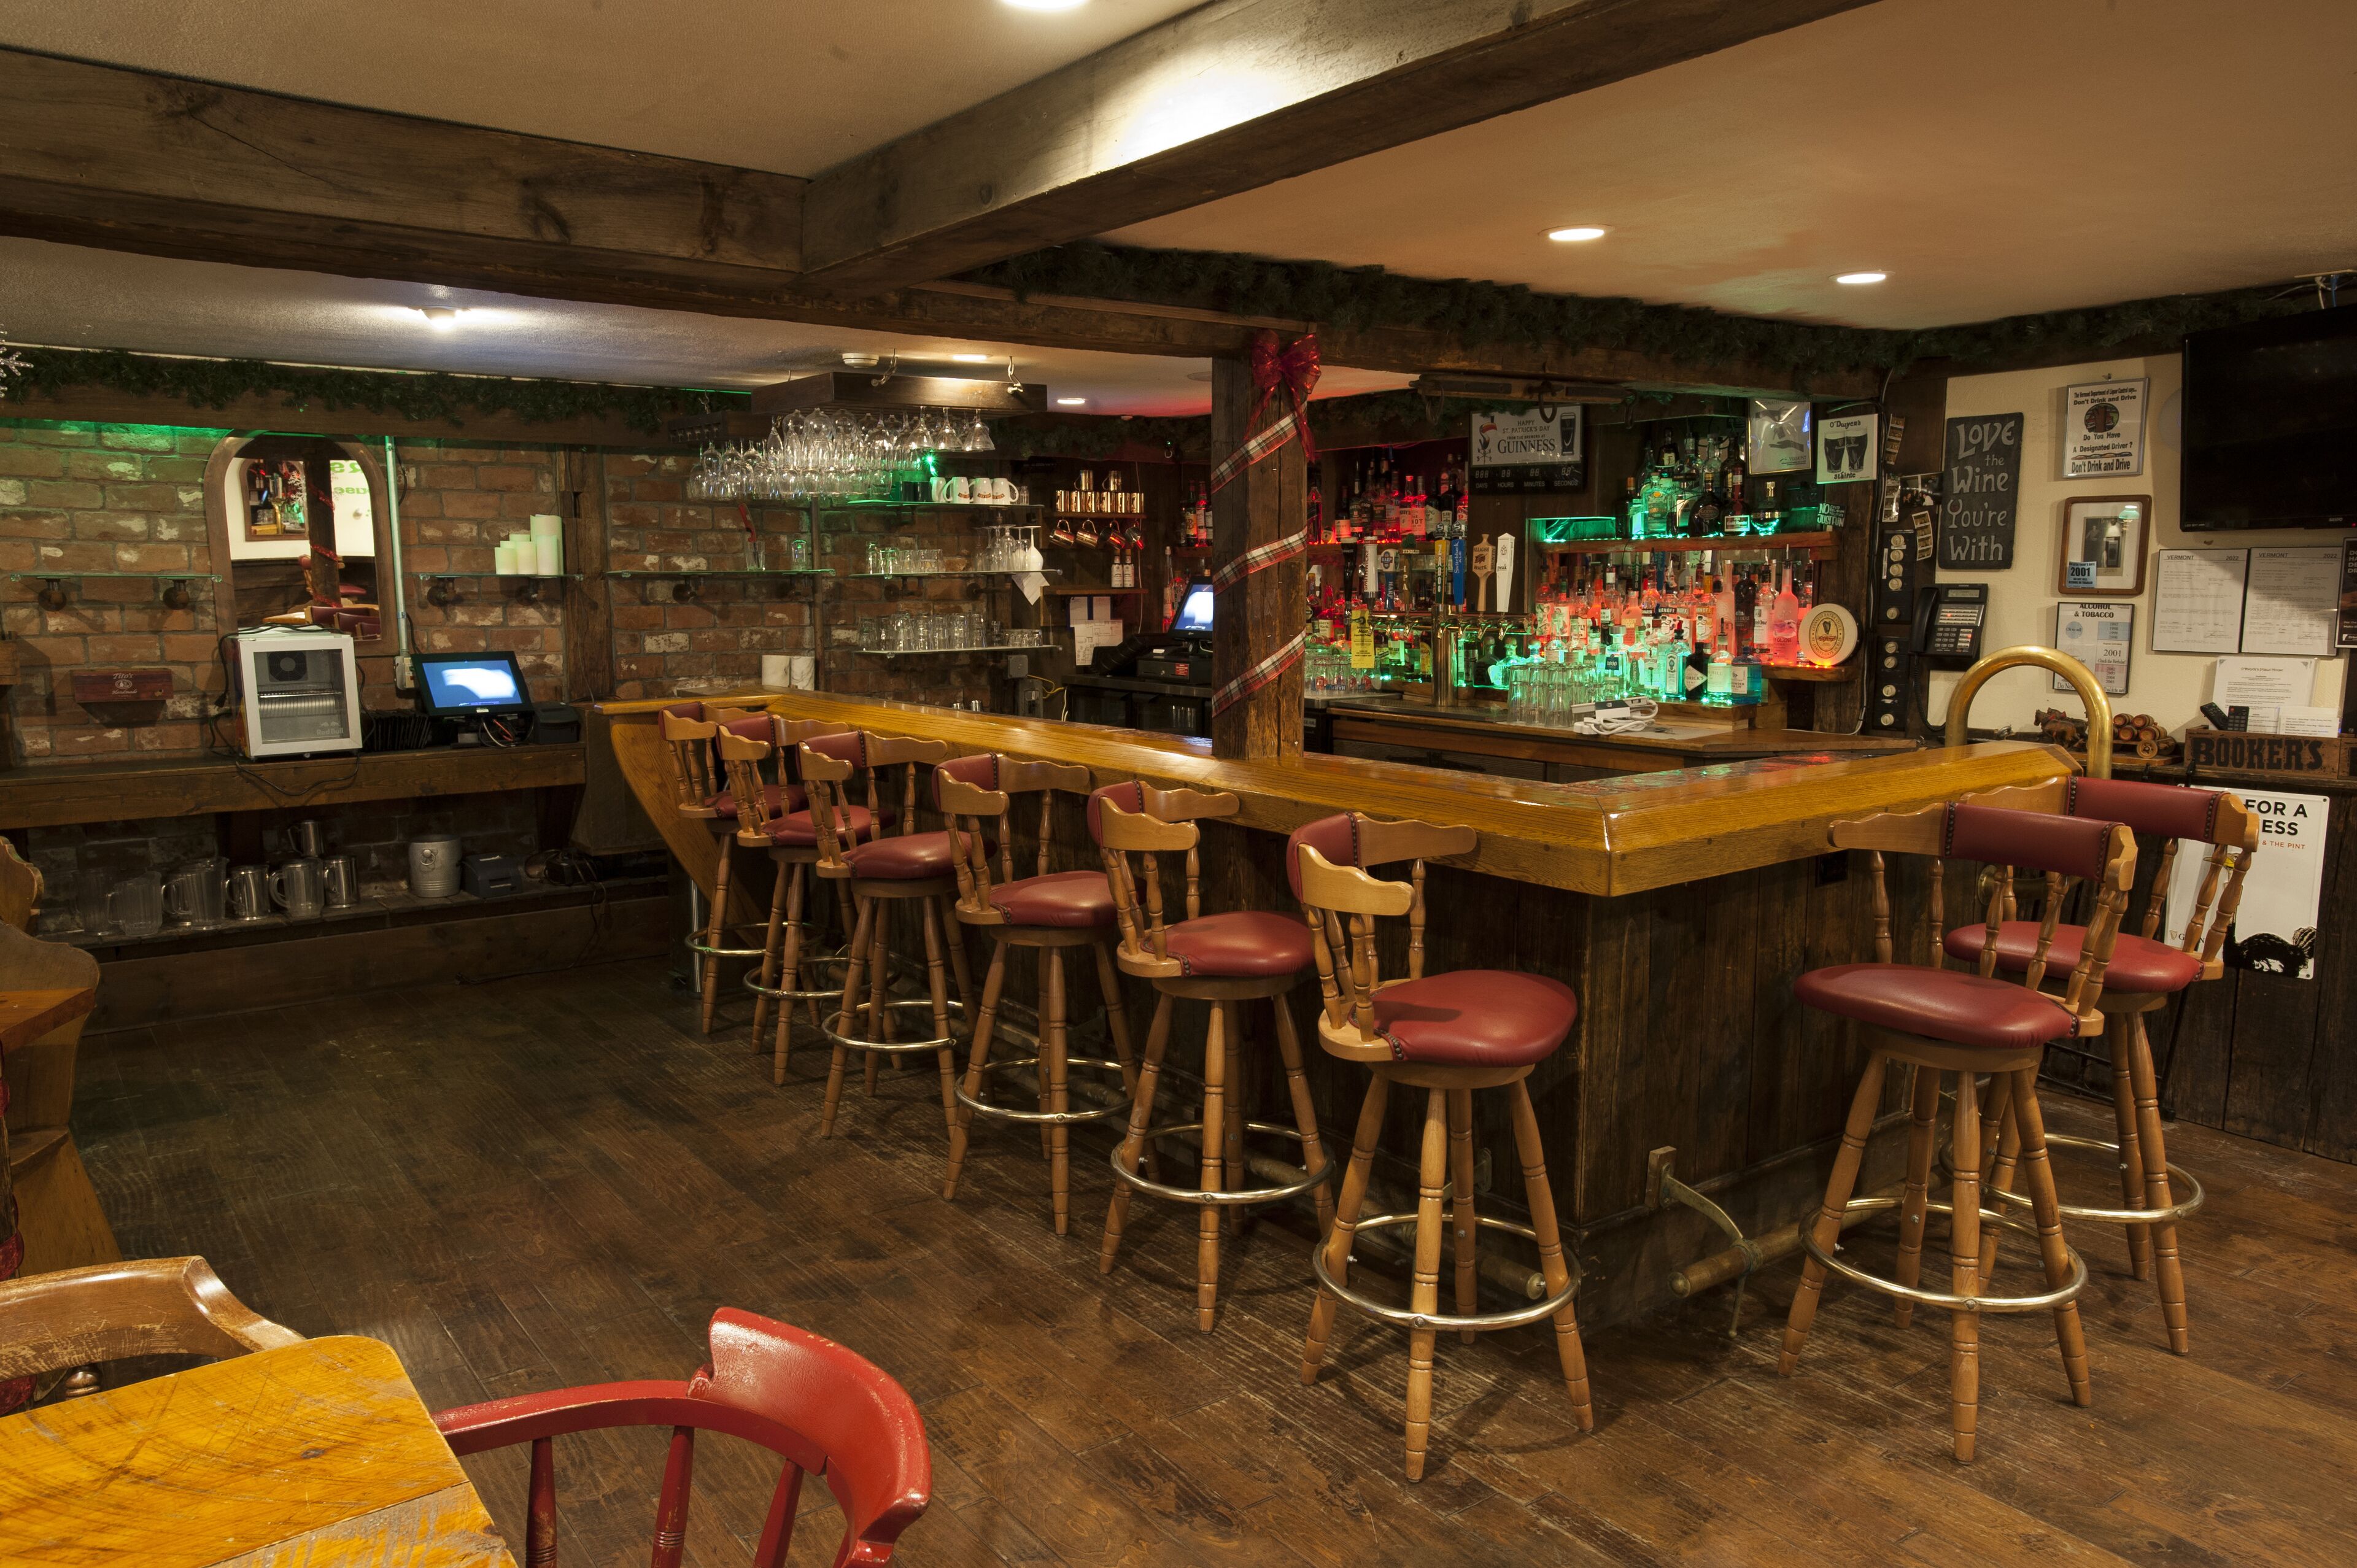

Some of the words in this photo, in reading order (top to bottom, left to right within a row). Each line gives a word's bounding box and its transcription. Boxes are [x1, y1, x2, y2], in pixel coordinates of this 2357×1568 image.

[1498, 438, 1555, 454] GUINNESS
[2080, 444, 2110, 453] Designated
[1984, 455, 2005, 466] the
[2072, 460, 2086, 473] Don't
[2087, 460, 2102, 472] Drink
[2103, 459, 2115, 471] and
[2115, 458, 2131, 471] Drive
[1951, 465, 2008, 495] Wine
[1948, 499, 2007, 528] You're
[1949, 535, 2003, 561] With
[2070, 567, 2091, 576] 2001
[2191, 737, 2323, 770] BOOKER'S
[2245, 800, 2286, 816] FOR
[2293, 804, 2308, 817] A
